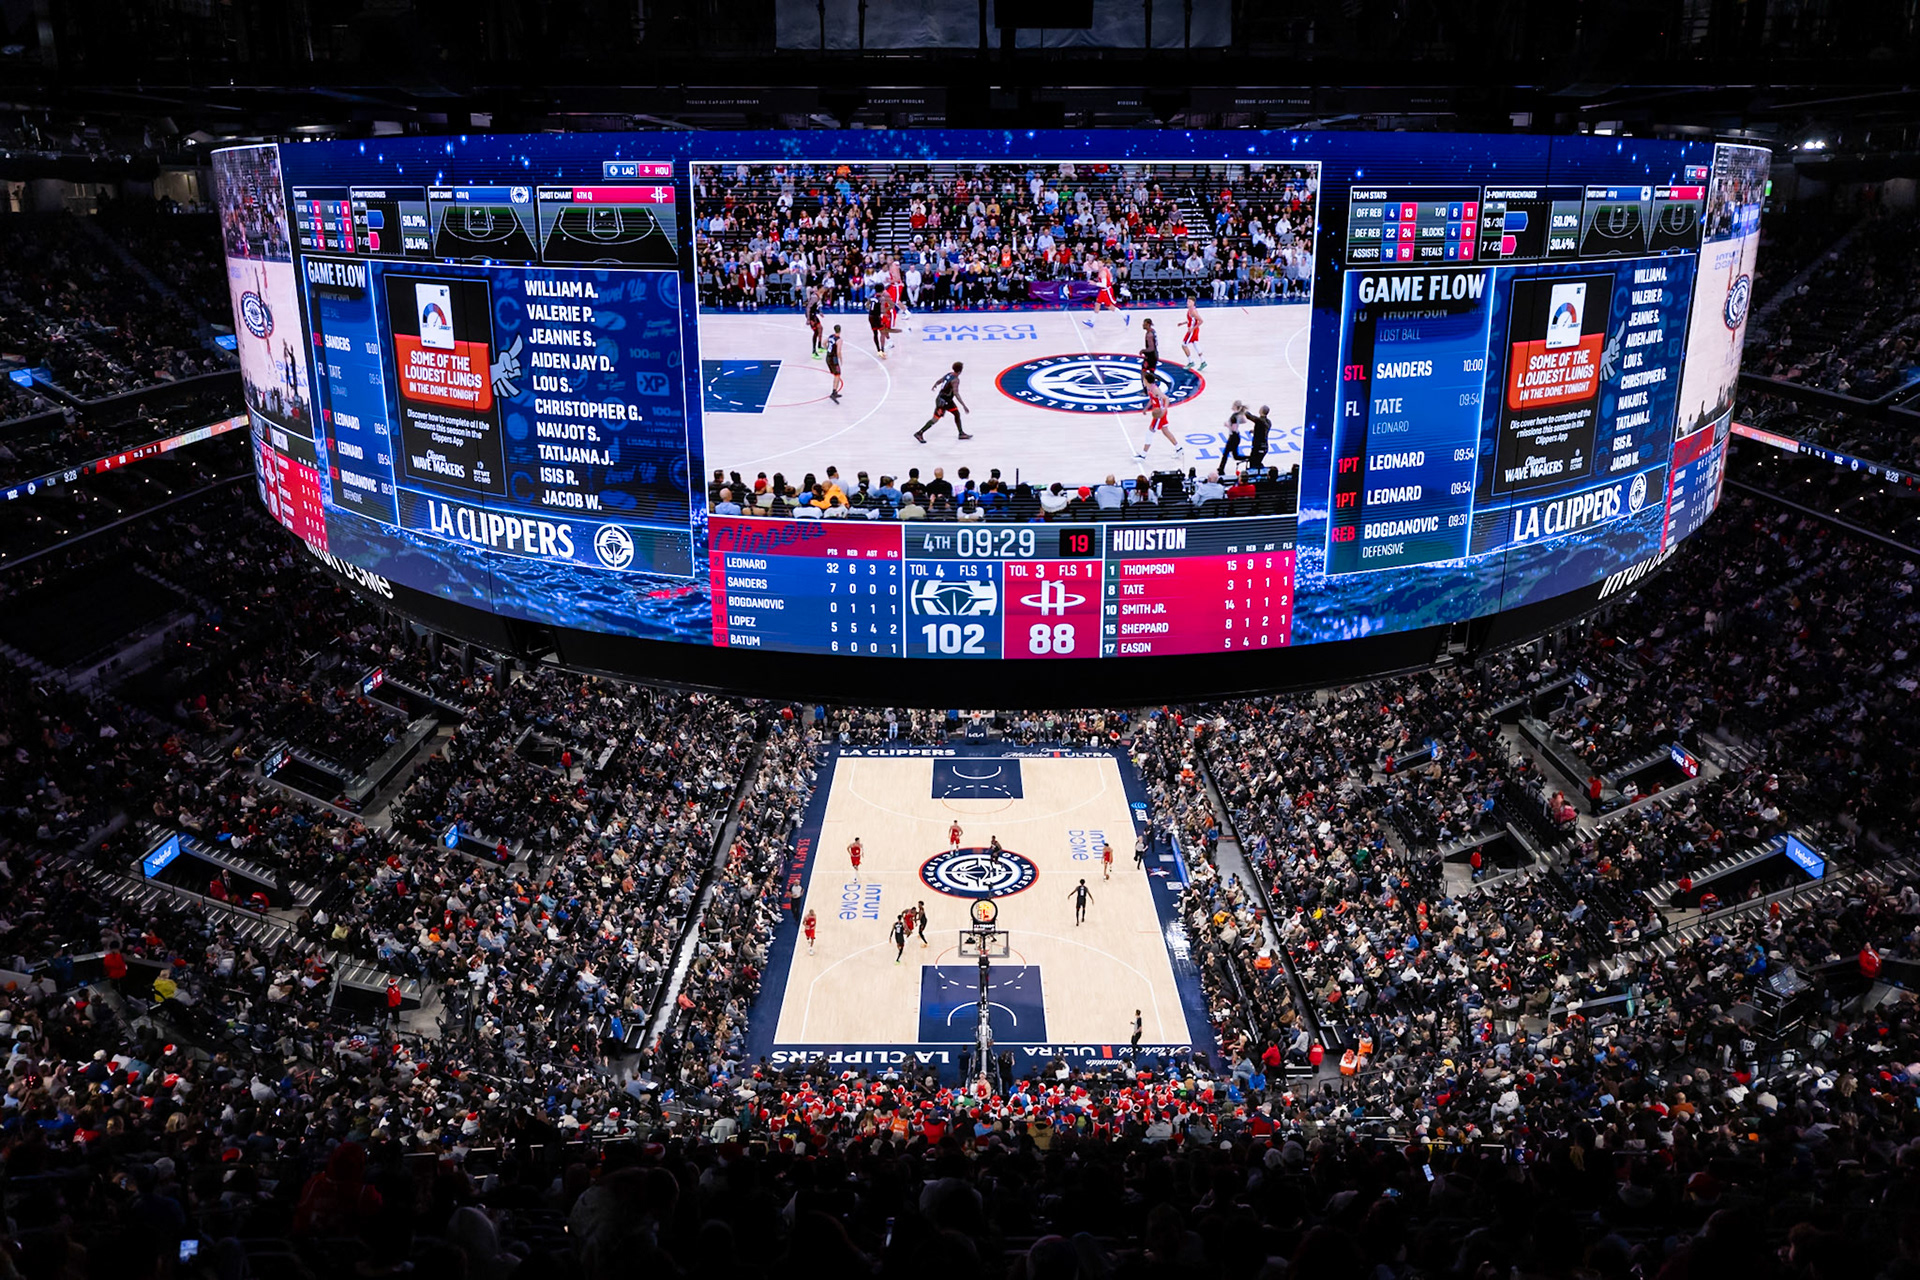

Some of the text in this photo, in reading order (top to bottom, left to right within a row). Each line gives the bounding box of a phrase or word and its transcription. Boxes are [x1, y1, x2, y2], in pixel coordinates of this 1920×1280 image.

[621, 166, 635, 175] LAC
[654, 166, 669, 175] HOU
[539, 191, 573, 200] SHOT CHART
[576, 191, 587, 200] 4TH
[1352, 191, 1388, 200] TEAM STATS
[402, 215, 426, 227] 50.0%
[1356, 208, 1413, 218] OFF REB 13
[1552, 215, 1578, 227] 50.0%
[1354, 228, 1412, 238] DEF REB 22 24
[1421, 227, 1445, 237] BLOCKS
[404, 238, 429, 250] 30.4%
[1421, 247, 1443, 257] STEALS
[1549, 238, 1575, 250] 30.4%
[1352, 248, 1410, 258] ASSISTS 19 19
[307, 261, 366, 289] GAME FLOW
[524, 280, 583, 299] WILLIAM
[584, 281, 599, 299] A.
[1358, 273, 1486, 304] GAME FLOW
[526, 303, 596, 323] VALERIE P.
[324, 334, 351, 352] SANDERS
[528, 328, 597, 347] JEANNE S.
[1379, 328, 1421, 342] LOST BALL
[410, 350, 471, 372] SOME OF THE
[531, 351, 615, 372] AIDEN JAY D.
[404, 364, 483, 389] LOUDEST LUNGS
[1343, 358, 1484, 382] STL SANDERS 10:00
[409, 381, 480, 402] IN THE DOME TONIGHT
[532, 375, 573, 394] LOU S.
[534, 398, 643, 422] CHRISTOPHER G.
[1345, 392, 1480, 417] FL TATE 09:54
[536, 421, 601, 442] NAVJOT S.
[1372, 420, 1410, 435] LEONARD
[537, 444, 615, 466] TATIJANA J.
[1337, 447, 1475, 474] 1PT LEONARD 09:54
[411, 455, 433, 472] WAVE
[433, 460, 466, 479] MAKERS
[539, 466, 580, 486] ISIS R.
[6, 489, 19, 500] 102
[541, 489, 603, 511] JACOB W.
[1335, 481, 1472, 509] 1PT LEONARD 09:54
[1513, 506, 1540, 542] LA
[1543, 484, 1623, 535] CLIPPERS
[427, 499, 576, 559] LA CLIPPERS
[1331, 513, 1468, 543] REB BOGDANOVIC 09:31
[922, 528, 1036, 558] 4TH 09:29
[1069, 534, 1089, 553] 19
[1112, 528, 1187, 552] HOUSTON
[1226, 542, 1293, 554] PTS REB AST FLS
[1362, 542, 1405, 559] DEFENSIVE
[726, 557, 840, 575] LEONARD 32
[909, 563, 945, 579] TOL 4
[959, 564, 994, 579] FLS 1
[1008, 564, 1046, 579] TOL 3
[1058, 564, 1093, 579] FLS 1
[1109, 560, 1237, 577] 1 THOMPSON 15
[727, 576, 768, 590] SANDERS
[1107, 584, 1145, 596] 8 TATE
[728, 596, 785, 611] BOGDANOVIC
[1104, 599, 1235, 616] 10 SMITH JR. 14
[729, 615, 757, 628] LOPEZ
[1104, 622, 1169, 636] 15 SHEPPARD
[729, 634, 761, 647] BATUM
[921, 623, 986, 655] 102
[1028, 623, 1075, 655] 88
[1104, 642, 1152, 655] 17 EASON
[840, 749, 957, 757] LA CLIPPERS
[914, 1050, 951, 1064] LA
